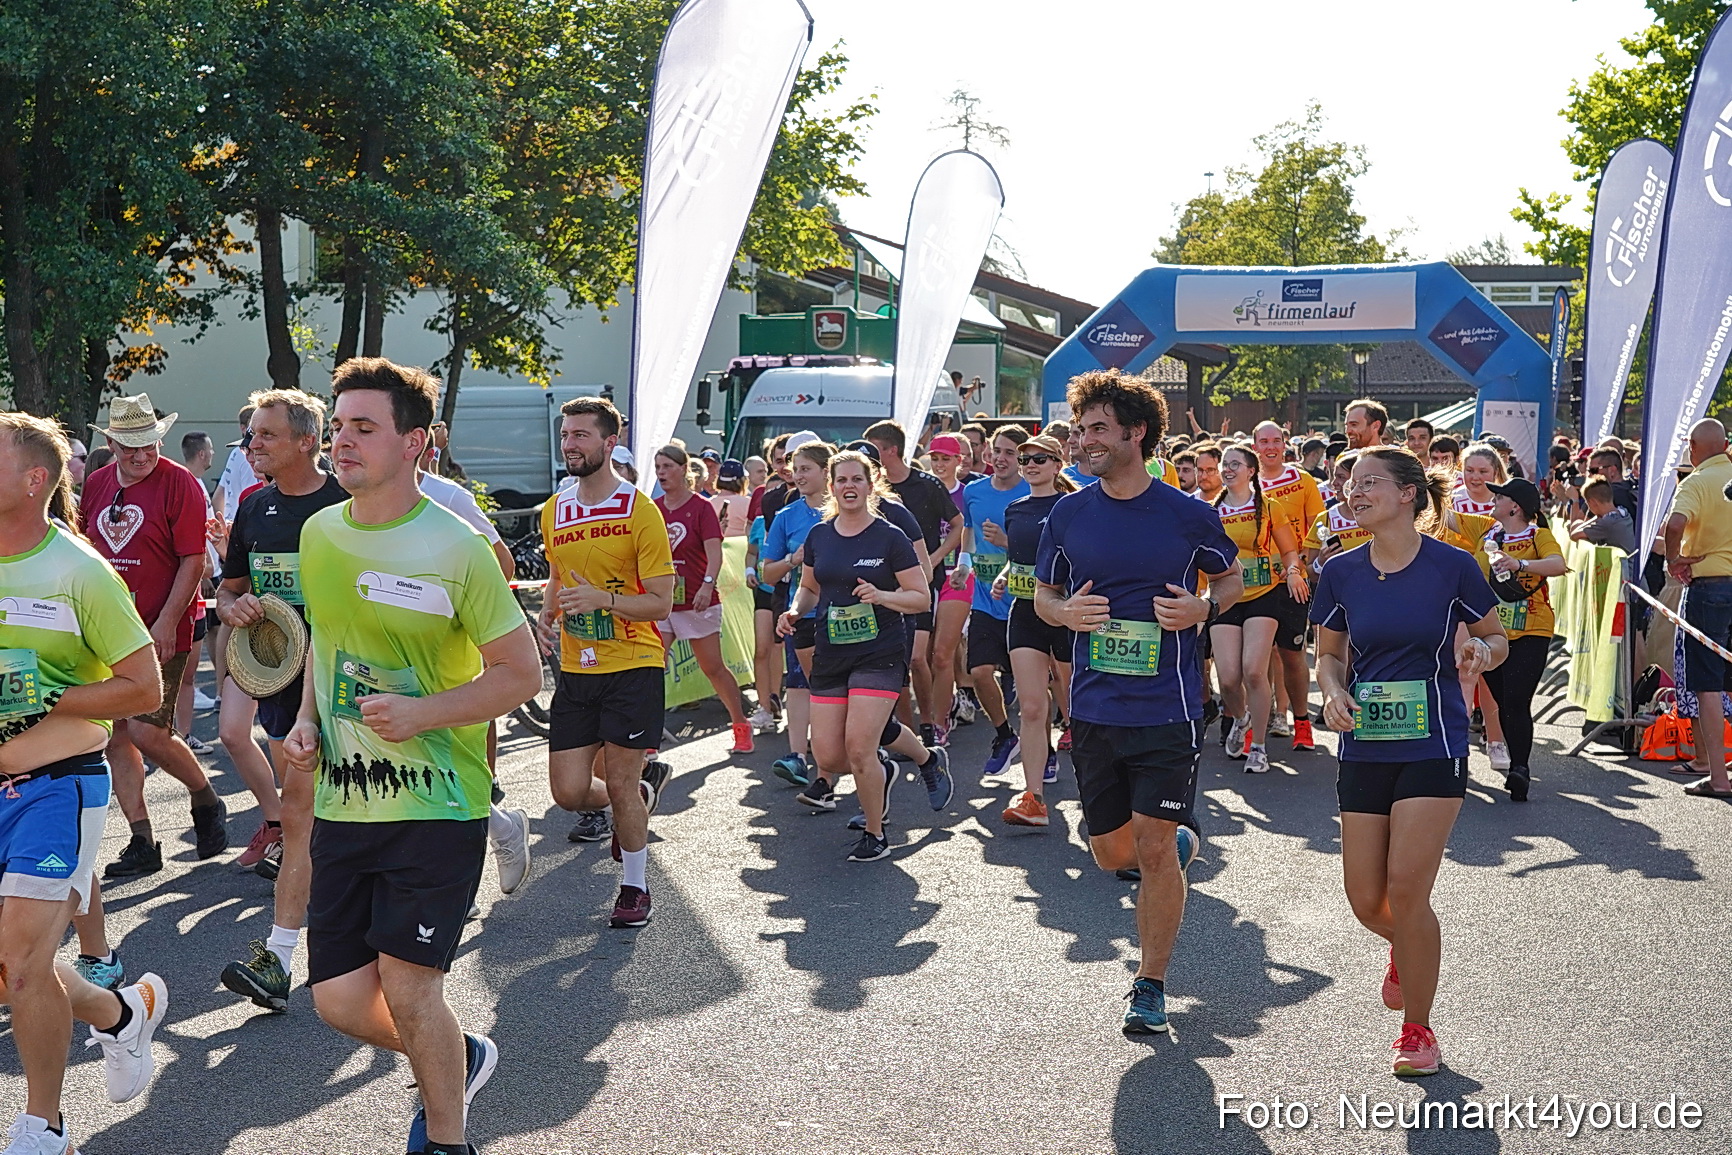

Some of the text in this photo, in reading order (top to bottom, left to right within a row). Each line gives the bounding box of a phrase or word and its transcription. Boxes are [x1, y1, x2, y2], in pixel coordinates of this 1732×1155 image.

[1617, 165, 1660, 268] Fischer
[1638, 179, 1668, 263] AUTOMOBILE
[1289, 287, 1320, 295] Fischer
[1267, 301, 1357, 320] firmenlauf
[1096, 330, 1145, 343] Fischer
[1444, 330, 1457, 339] und
[1458, 328, 1471, 336] das
[1275, 484, 1305, 499] BÖGL
[552, 523, 632, 548] MAX BÖGL
[1339, 532, 1353, 540] AX
[262, 571, 295, 589] 285
[395, 580, 423, 591] Klinikum
[1014, 575, 1037, 589] 116
[394, 586, 422, 597] Neumarkt
[32, 602, 57, 612] Klinikum
[585, 616, 594, 635] 2022
[834, 615, 869, 633] 1168
[1092, 641, 1100, 660] RUN
[1104, 637, 1142, 658] 954
[1120, 657, 1149, 665] Sebastian
[1147, 643, 1157, 669] 2022
[25, 672, 38, 705] 2022
[338, 681, 348, 705] RUN
[0, 696, 28, 707] Markus
[1368, 701, 1408, 722] 950
[1416, 703, 1425, 731] 2022
[1362, 722, 1390, 730] Freihart
[1160, 800, 1182, 810] JAKO
[416, 936, 432, 944] erima
